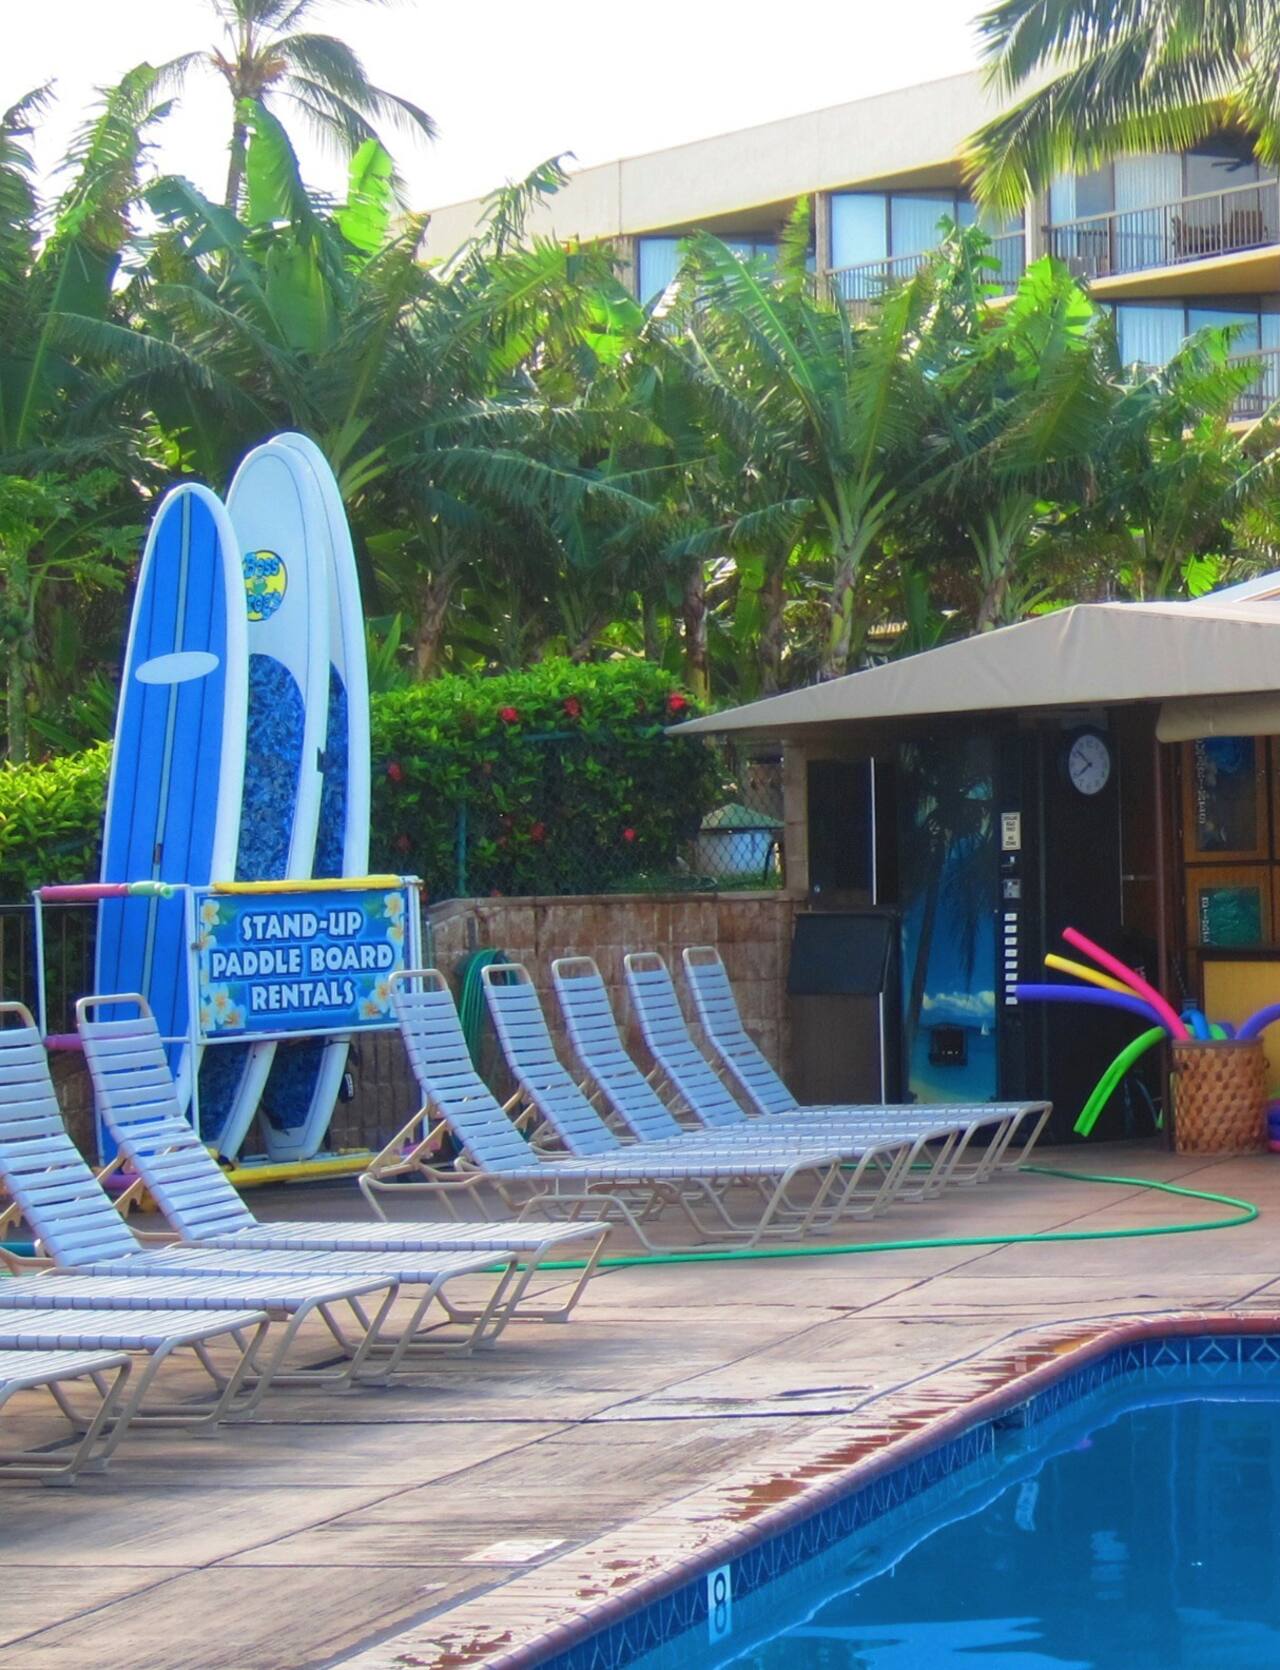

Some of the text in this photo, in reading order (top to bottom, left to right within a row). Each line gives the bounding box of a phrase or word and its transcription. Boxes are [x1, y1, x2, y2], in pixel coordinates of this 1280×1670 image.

[242, 911, 362, 941] STAND-UP
[212, 944, 394, 978] PADDLE BOARD
[252, 980, 354, 1011] RENTALS
